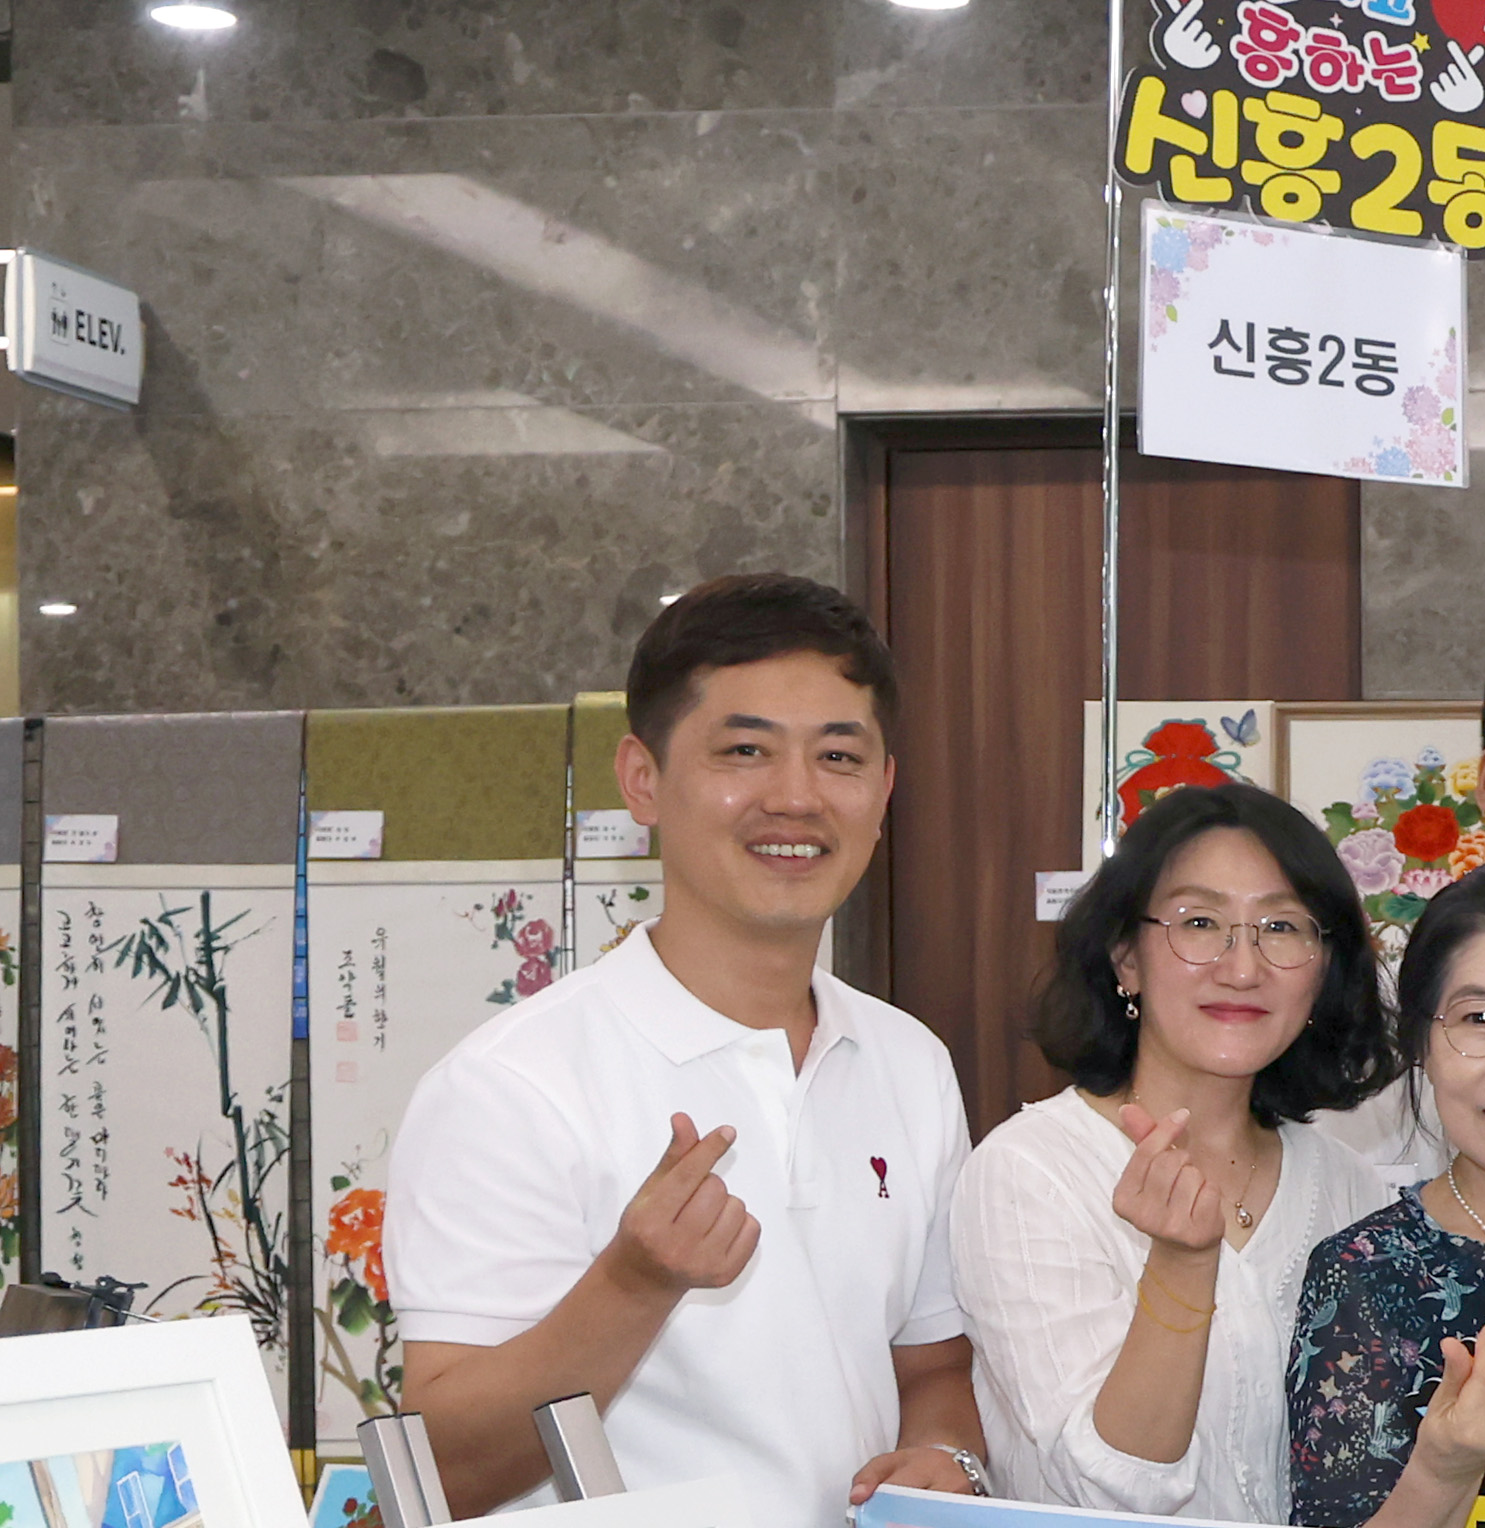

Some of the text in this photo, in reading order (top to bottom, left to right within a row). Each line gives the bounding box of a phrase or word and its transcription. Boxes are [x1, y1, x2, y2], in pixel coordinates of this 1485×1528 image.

[1235, 6, 1418, 96] 흥하는
[75, 309, 125, 355] ELEV.
[1207, 318, 1400, 397] 신흥2동
